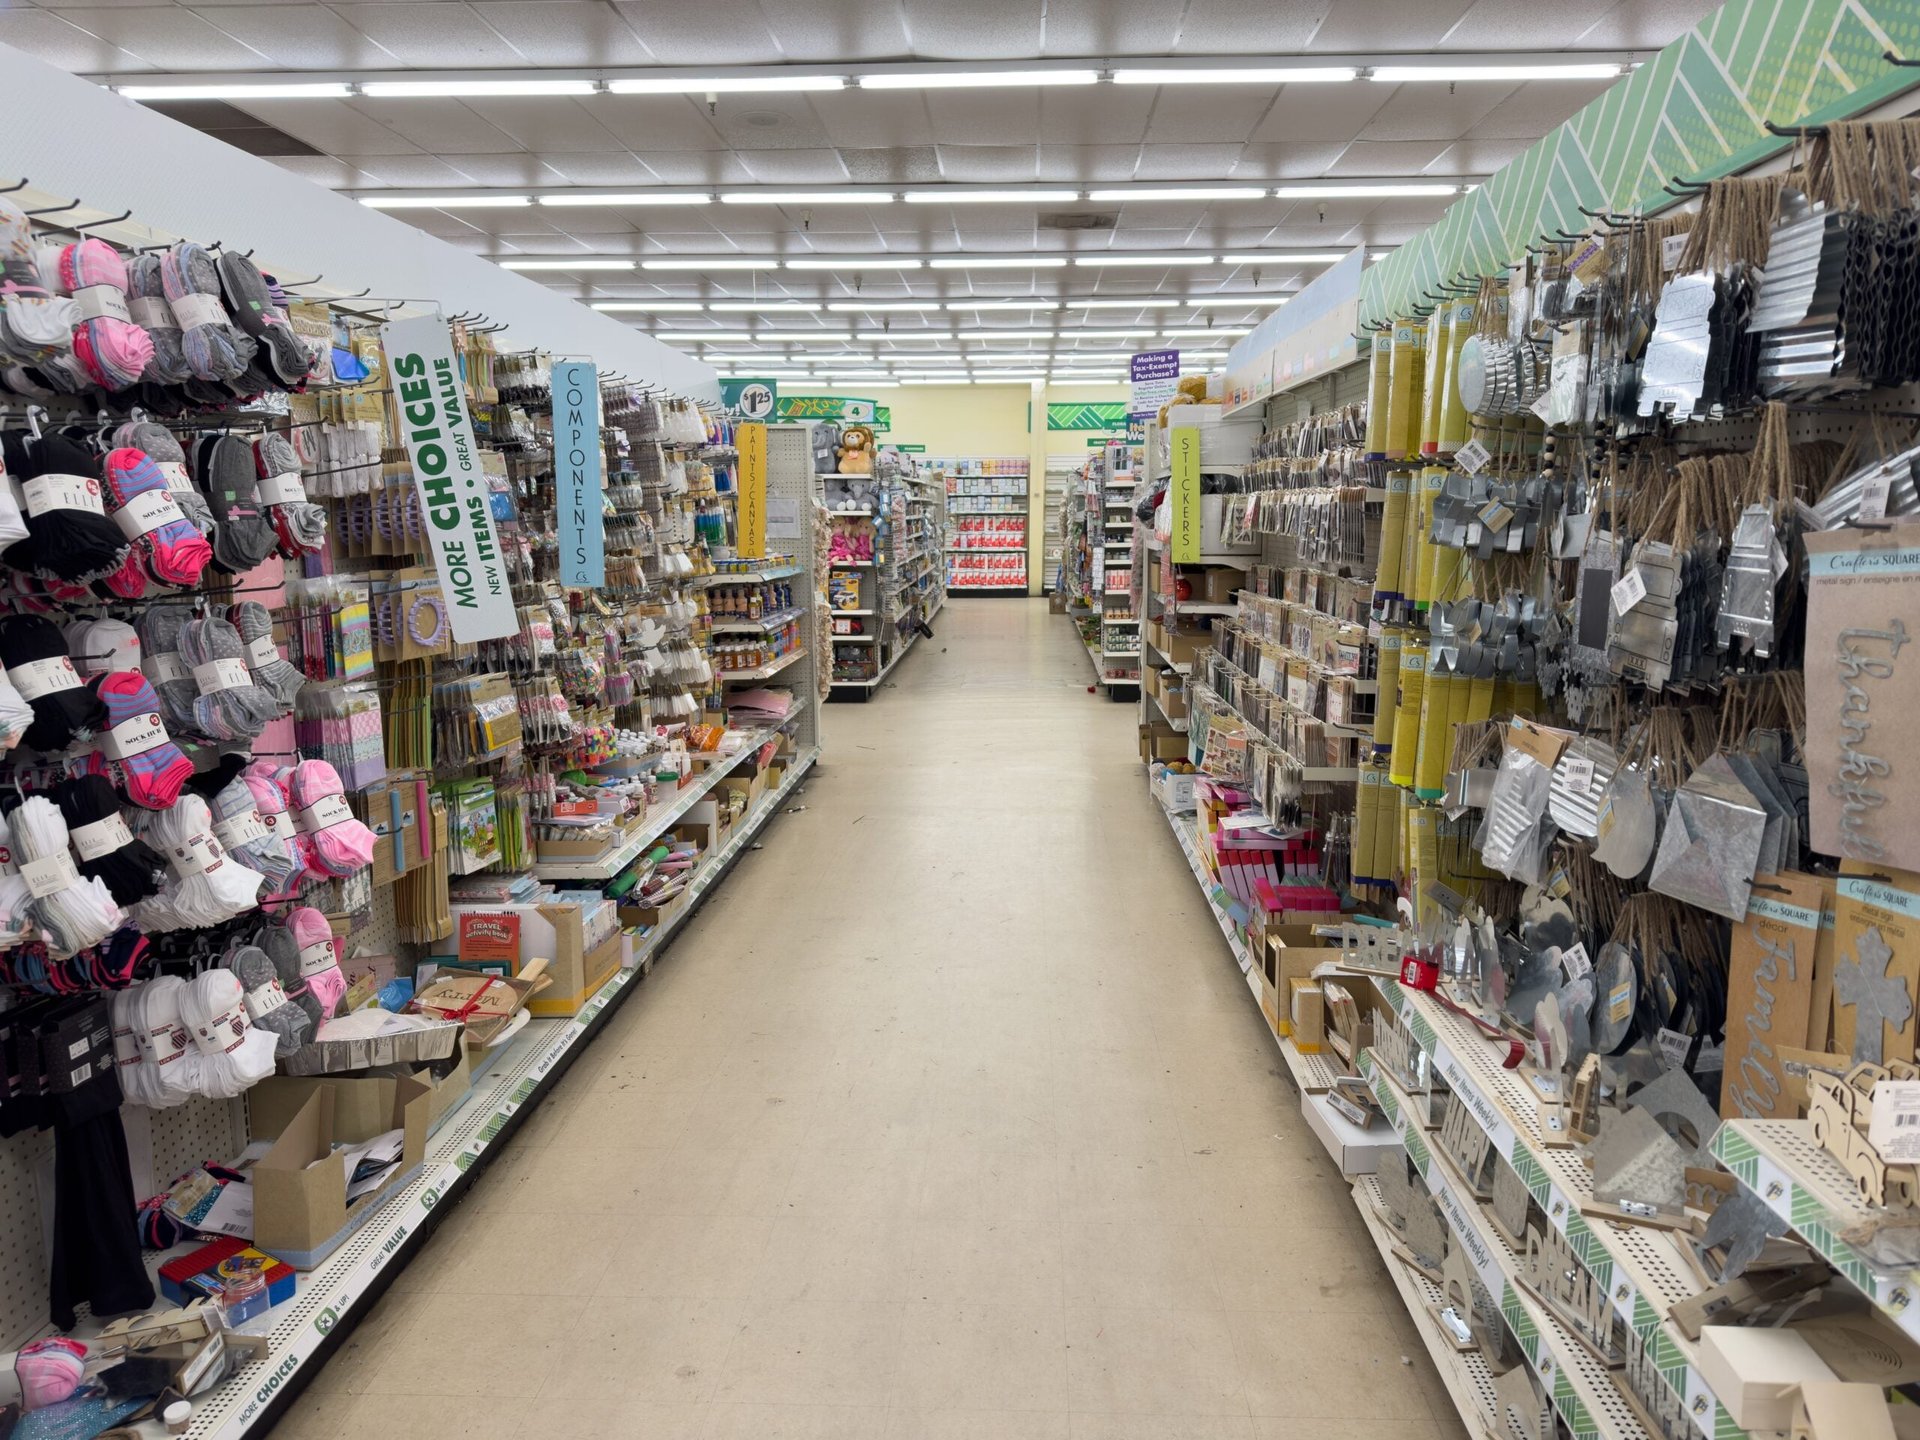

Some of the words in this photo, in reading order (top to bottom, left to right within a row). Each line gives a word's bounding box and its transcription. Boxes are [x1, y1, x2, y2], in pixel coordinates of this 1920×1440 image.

[1133, 362, 1177, 372] Tax-Exempt
[1136, 355, 1166, 363] Making
[1136, 370, 1174, 379] Purchase?
[434, 357, 461, 429] VALUE
[852, 407, 860, 416] 4
[1127, 431, 1144, 441] We
[1129, 423, 1144, 431] Ite
[394, 352, 461, 531] CHOICES
[459, 433, 473, 471] GREAT
[567, 369, 586, 565] COMPONENTS
[748, 426, 756, 546] PAINTS/CANVAS
[1181, 438, 1190, 546] STICKERS
[467, 496, 496, 561] ITEMS
[1883, 553, 1920, 566] SQUARE
[444, 541, 478, 609] MORE
[487, 566, 502, 596] NEW
[1816, 577, 1837, 585] metal
[1840, 577, 1856, 586] sign
[1863, 576, 1900, 586] enseigne
[125, 734, 146, 745] SOCK
[147, 728, 161, 737] HUB
[322, 809, 338, 818] SOCK
[1883, 891, 1909, 908] SQUARE
[1780, 906, 1810, 922] SQUARE
[466, 930, 491, 938] activity
[492, 931, 508, 939] book
[538, 1060, 549, 1073] Grab
[550, 1045, 563, 1059] Before
[566, 1027, 577, 1040] Gone!
[1446, 1063, 1460, 1085] New
[1458, 1079, 1475, 1102] Items
[1473, 1097, 1498, 1132] Weekly!
[439, 1179, 448, 1190] UP!
[1438, 1186, 1454, 1209] New
[1452, 1206, 1468, 1232] Items
[1464, 1226, 1490, 1270] Weekly!
[370, 1250, 385, 1270] GREAT
[383, 1225, 408, 1254] VALUE
[1523, 1222, 1614, 1357] DREAM
[334, 1304, 342, 1312] &
[338, 1294, 350, 1308] UP!
[238, 1399, 259, 1426] MORE
[256, 1354, 299, 1405] CHOICES
